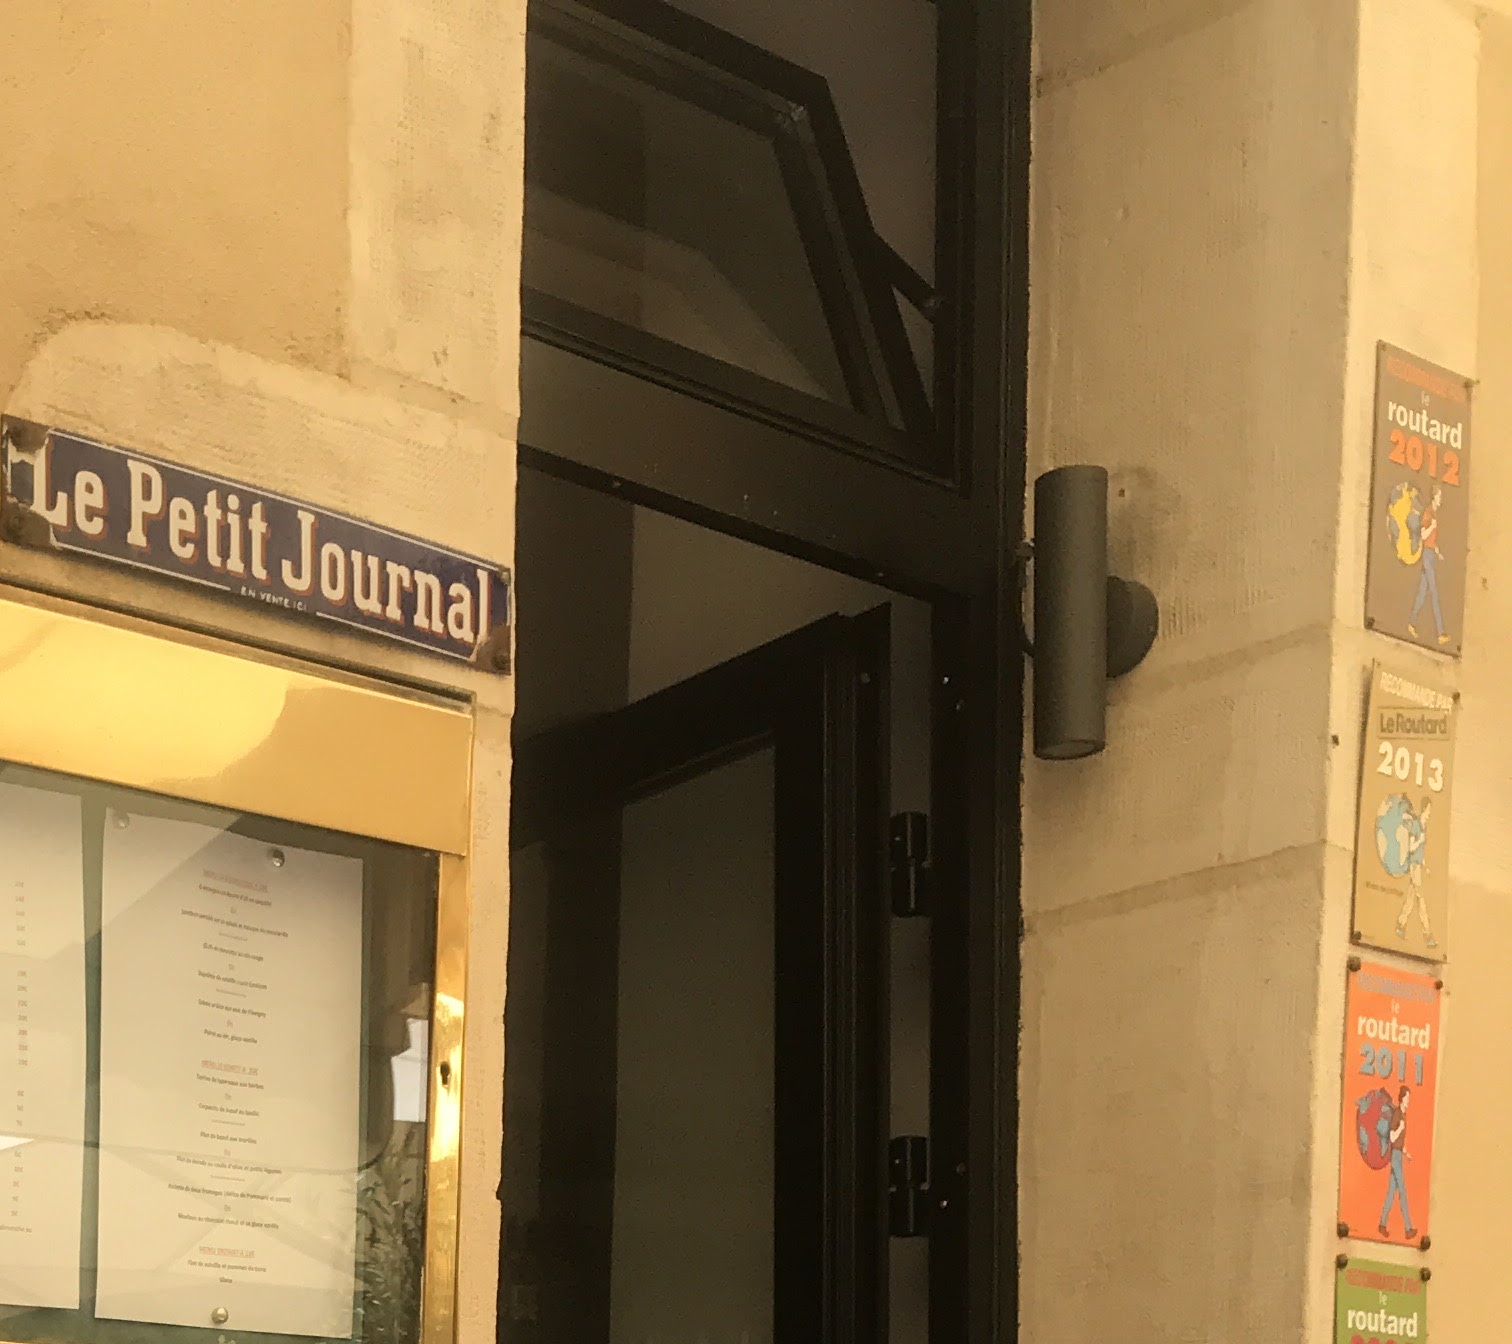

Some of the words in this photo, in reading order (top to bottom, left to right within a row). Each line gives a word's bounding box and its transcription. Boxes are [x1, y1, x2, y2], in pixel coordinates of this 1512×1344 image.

[1388, 401, 1462, 449] routard
[1388, 429, 1460, 486] 2012
[31, 433, 106, 537] Le
[126, 459, 269, 582] Petit
[281, 509, 489, 643] Journal
[240, 586, 256, 598] EN
[1377, 741, 1444, 792] 2013
[1357, 1016, 1430, 1050] routard
[1359, 1043, 1424, 1087] 2011
[1347, 1309, 1418, 1338] routard
